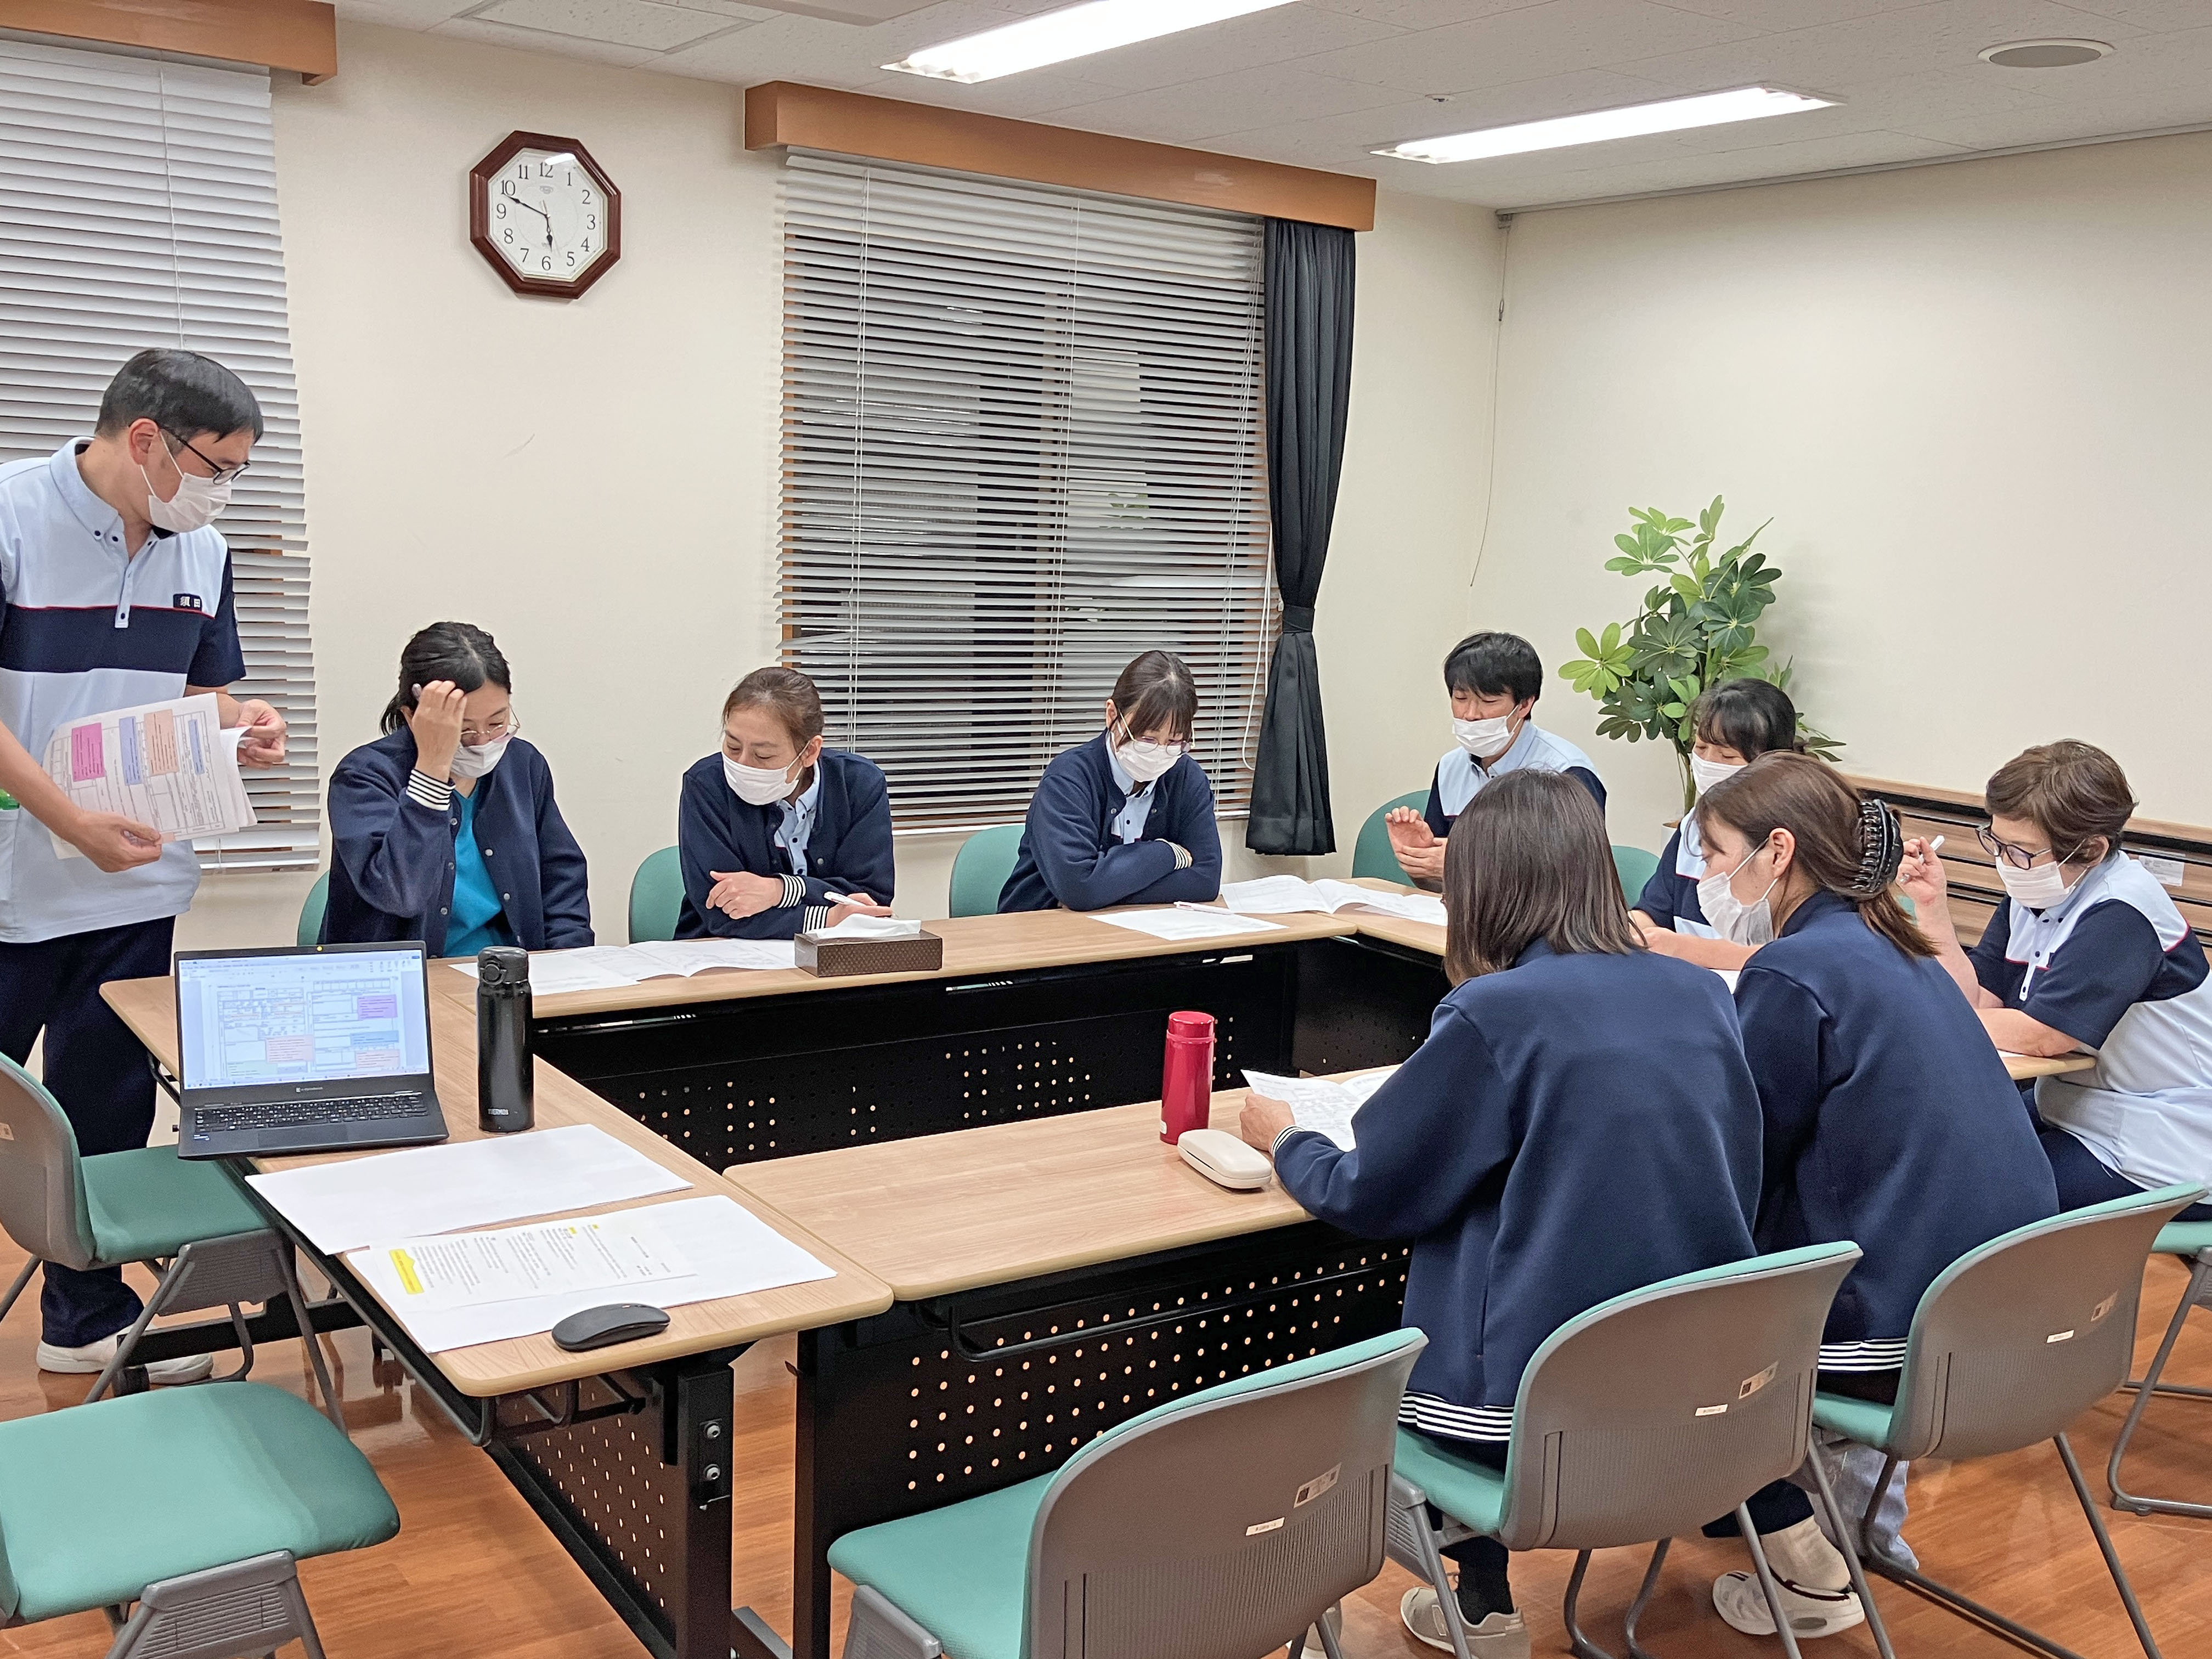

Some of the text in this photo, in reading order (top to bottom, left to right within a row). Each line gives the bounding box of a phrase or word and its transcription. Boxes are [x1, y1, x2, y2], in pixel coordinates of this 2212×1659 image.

[518, 164, 529, 180] 11
[539, 162, 554, 178] 12
[567, 172, 572, 186] 1
[501, 179, 516, 196] 10
[582, 189, 591, 205] 2
[496, 204, 506, 219] 9
[587, 214, 596, 230] 3
[504, 228, 514, 244] 8
[580, 237, 590, 252] 4
[520, 247, 529, 263] 7
[541, 256, 551, 270] 6
[566, 251, 575, 267] 5
